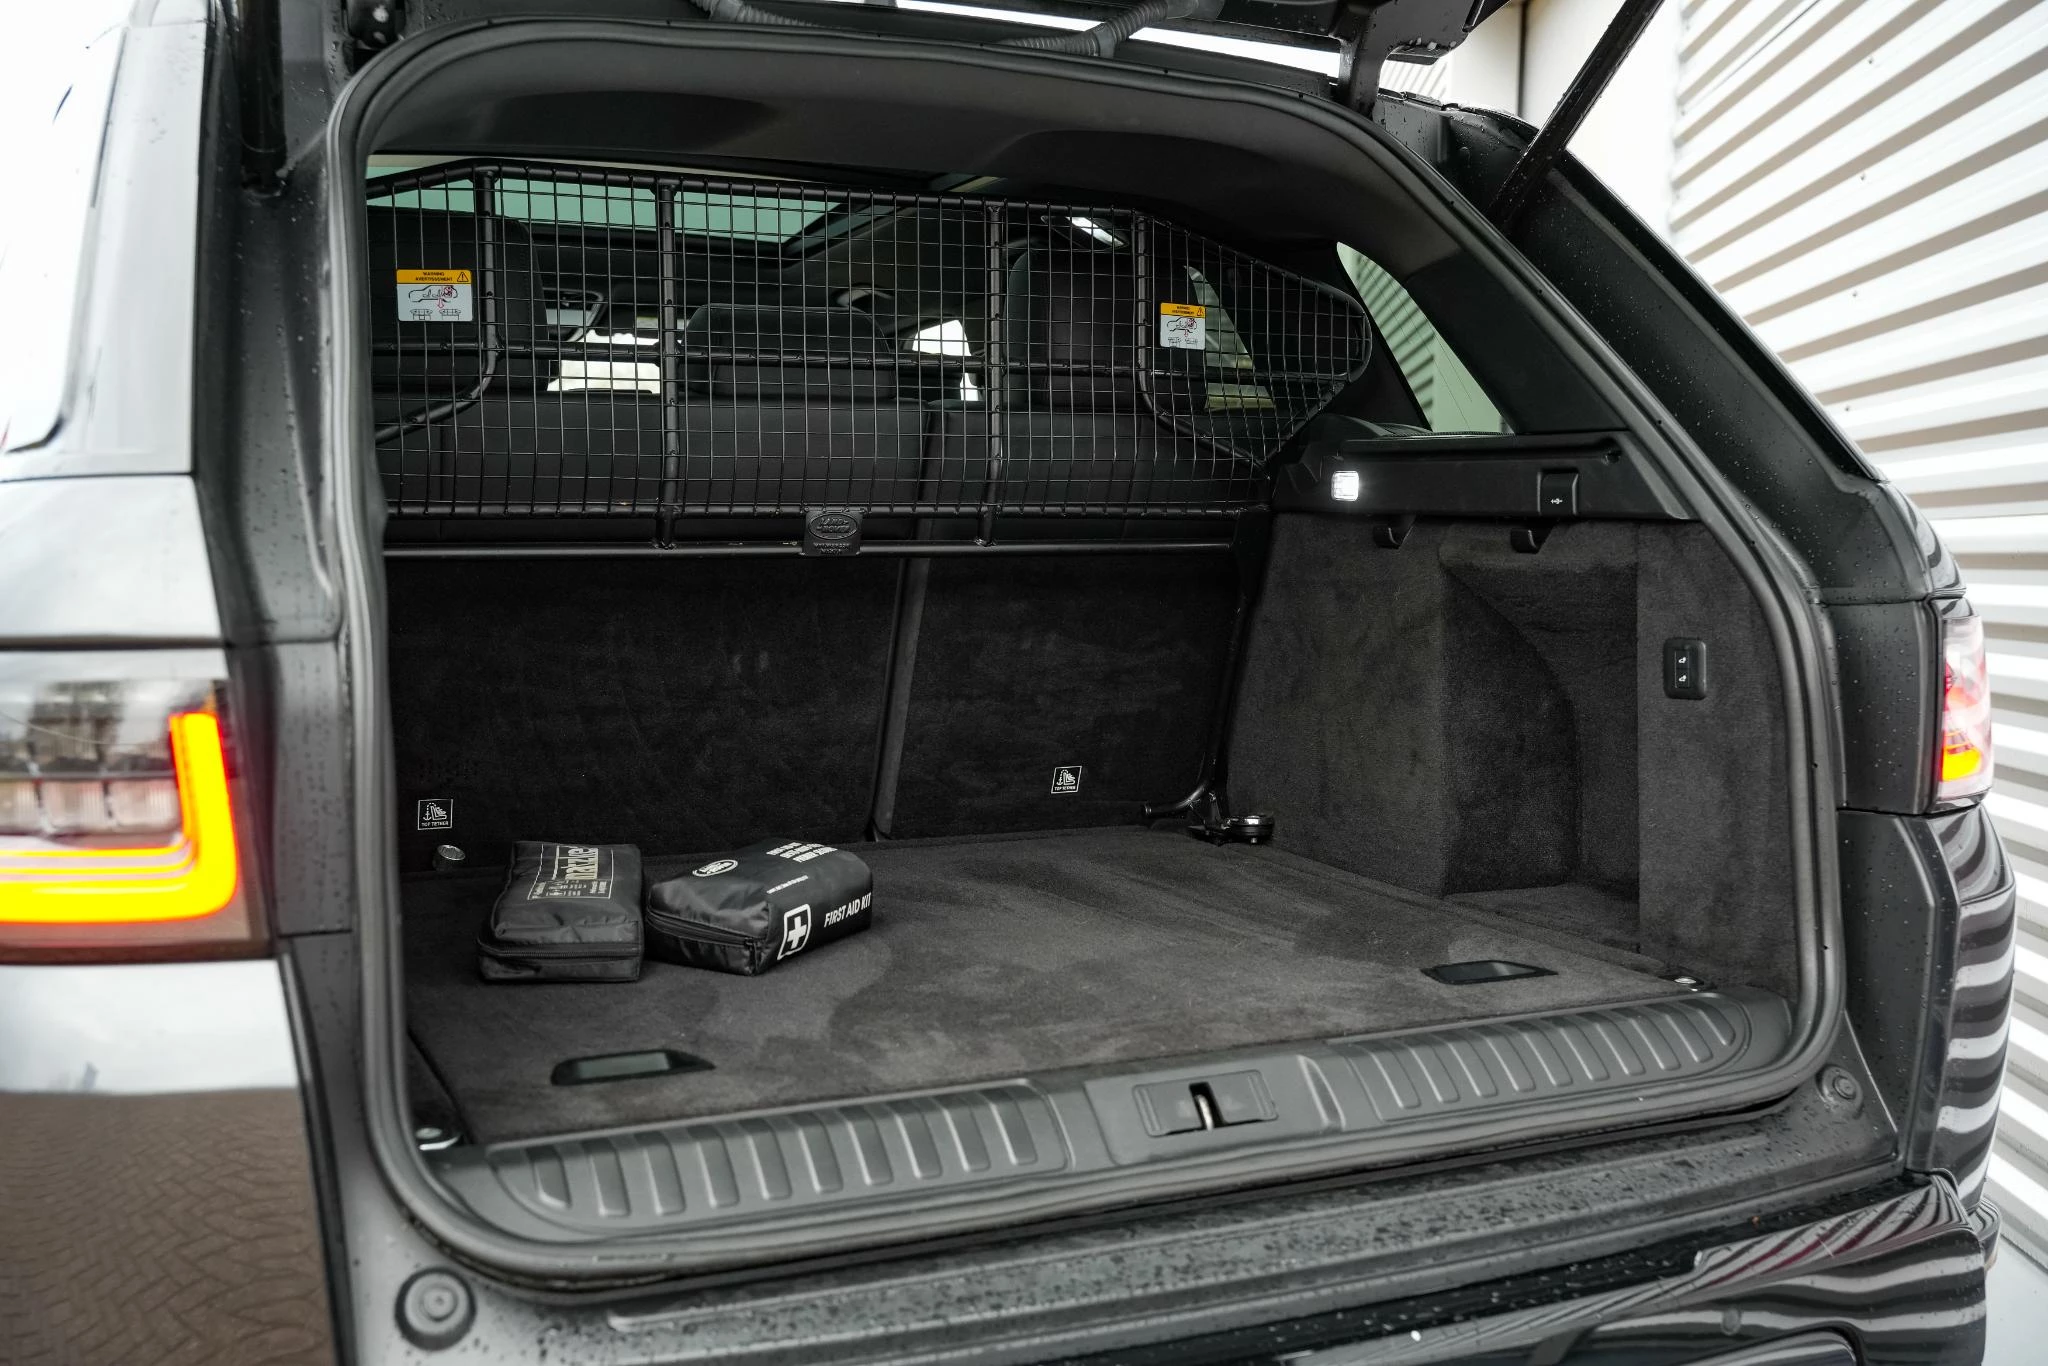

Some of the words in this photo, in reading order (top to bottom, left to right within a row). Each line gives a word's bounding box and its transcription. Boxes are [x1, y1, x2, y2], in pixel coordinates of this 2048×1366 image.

[824, 904, 846, 928] FIRST
[846, 898, 860, 918] AID
[860, 891, 872, 911] KIT
